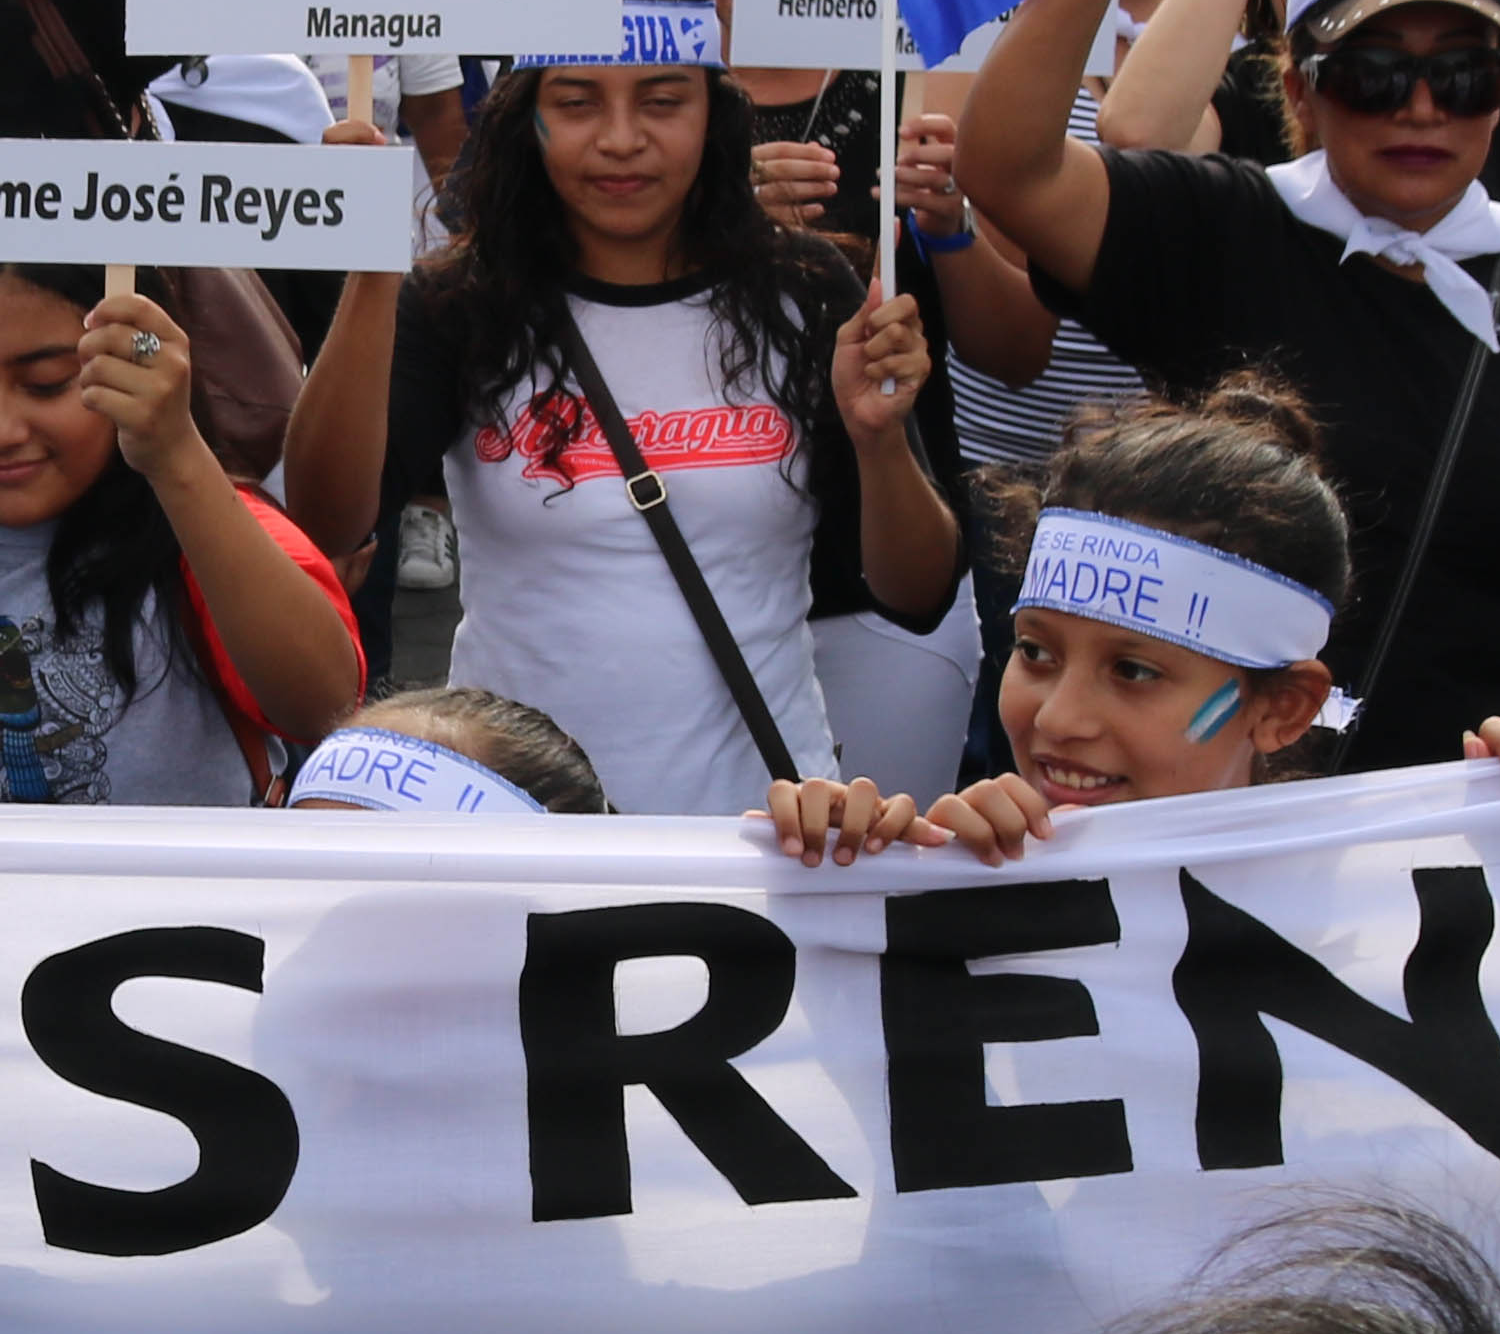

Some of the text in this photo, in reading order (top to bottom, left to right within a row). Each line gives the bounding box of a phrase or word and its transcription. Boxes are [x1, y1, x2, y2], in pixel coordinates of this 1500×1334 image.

[305, 5, 444, 43] Managua
[622, 15, 682, 64] GUA
[72, 171, 186, 223] José
[199, 173, 346, 242] Reyes
[474, 391, 798, 465] Nicragua
[1051, 531, 1162, 570] SE RINDA
[1030, 557, 1164, 624] MADRE
